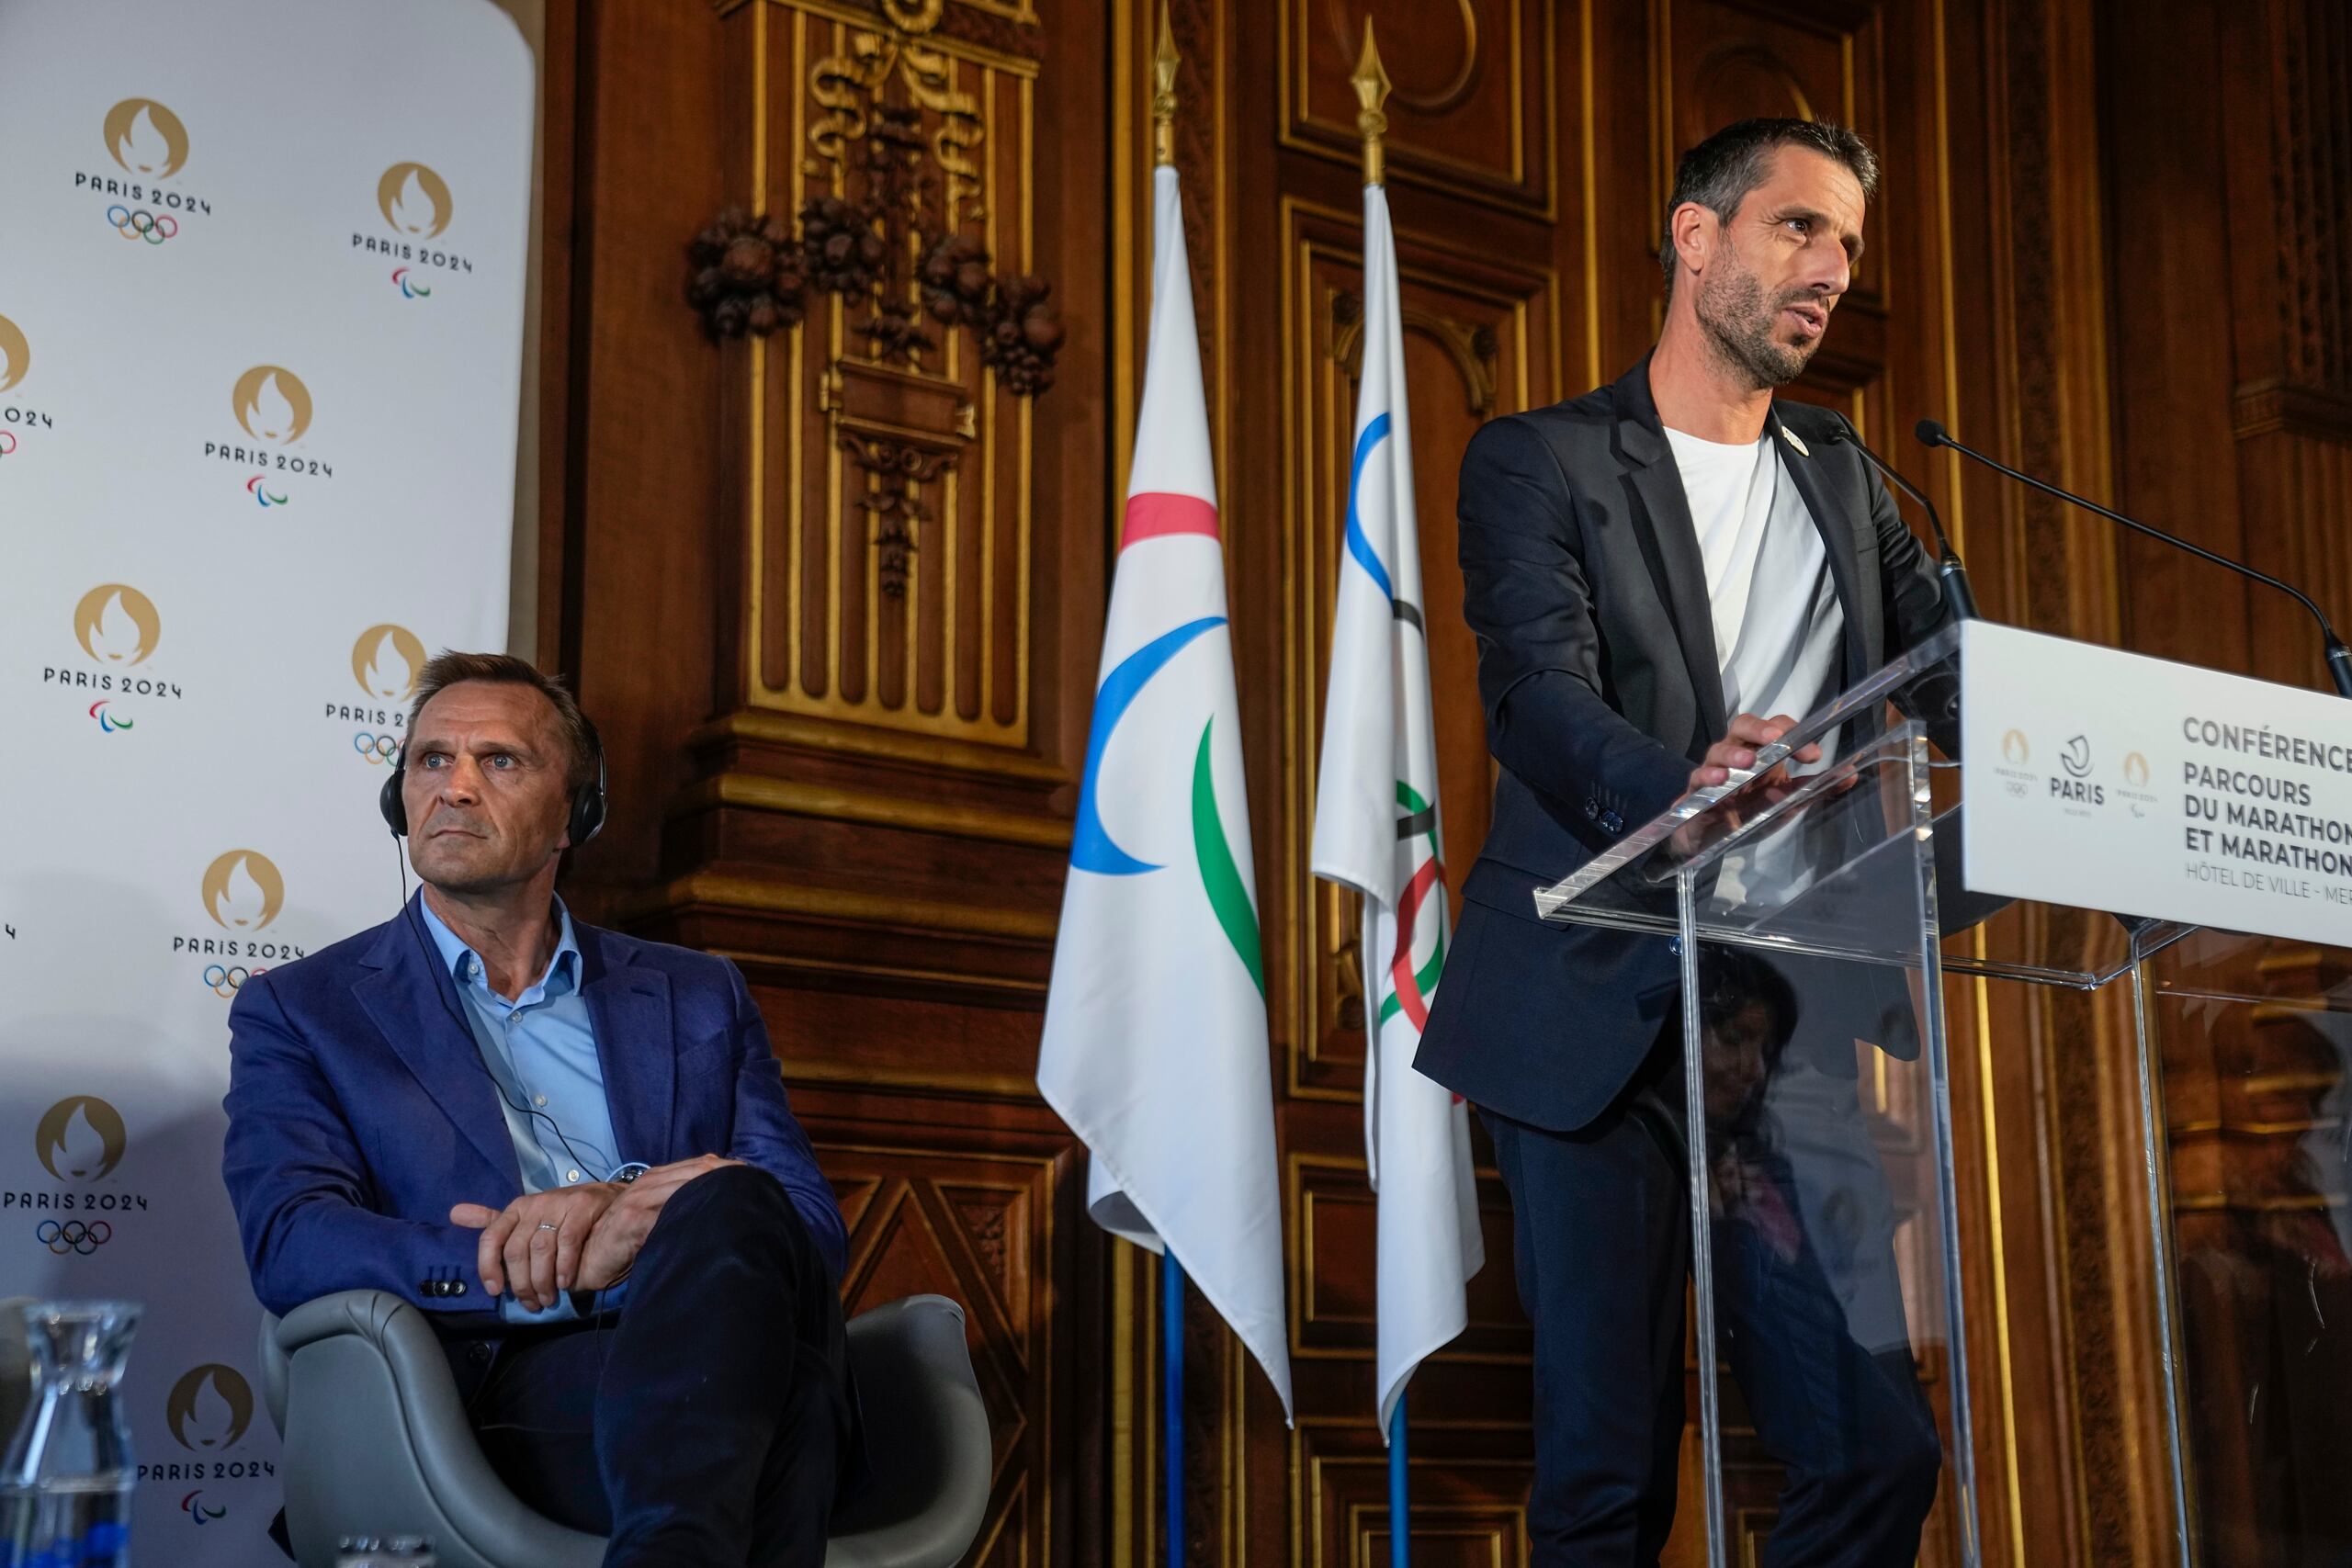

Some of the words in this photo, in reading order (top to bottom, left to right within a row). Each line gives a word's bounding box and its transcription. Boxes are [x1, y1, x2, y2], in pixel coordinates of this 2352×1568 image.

[75, 172, 142, 200] PARIS
[152, 189, 211, 215] 2024
[352, 232, 411, 260] PARIS
[420, 248, 472, 274] 2024
[5, 407, 52, 429] 024
[205, 441, 267, 467] PARIS
[277, 455, 333, 478] 2024
[44, 667, 111, 690] PARIS
[121, 677, 182, 699] 2024
[325, 704, 386, 725] PARIS
[2050, 777, 2104, 806] PARIS
[2184, 761, 2312, 807] PARCOURS
[2185, 794, 2218, 821] DU
[2186, 827, 2213, 853] ET
[2222, 833, 2352, 877] MARATHON
[2186, 862, 2239, 886] HÔTEL
[2243, 872, 2264, 891] DE
[2268, 875, 2312, 898] VILLE
[2324, 885, 2352, 905] ME
[174, 936, 238, 955] PARIS
[247, 942, 304, 959] 2024
[4, 1192, 74, 1209] PARIS
[85, 1194, 147, 1211] 2024
[138, 1463, 205, 1481] PARIS
[214, 1461, 275, 1478] 2024
